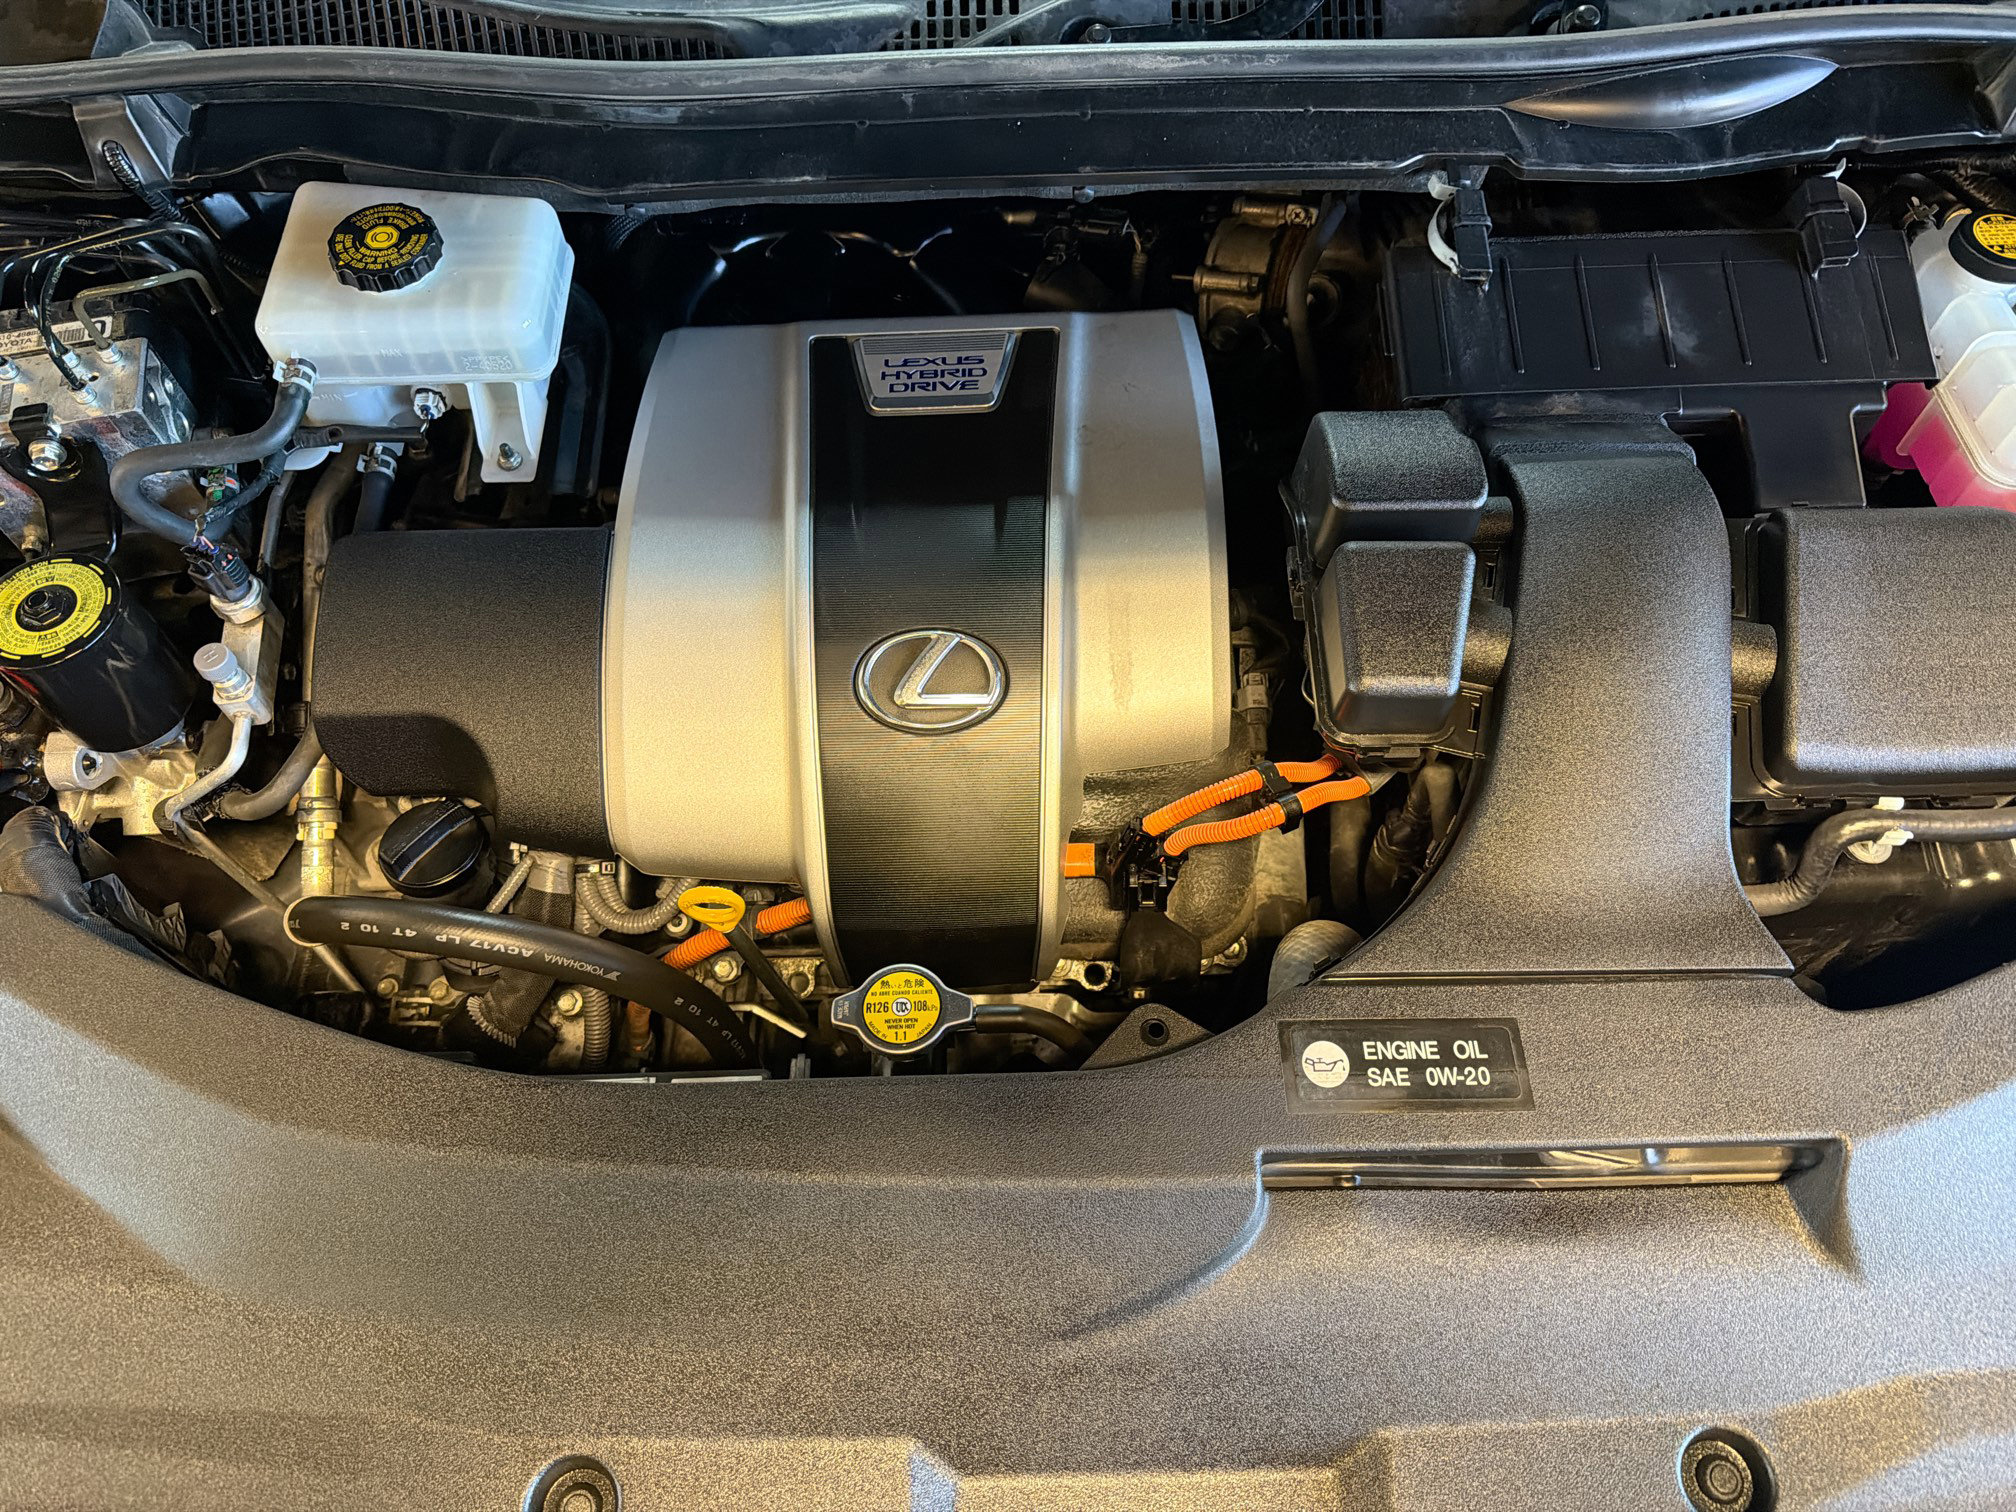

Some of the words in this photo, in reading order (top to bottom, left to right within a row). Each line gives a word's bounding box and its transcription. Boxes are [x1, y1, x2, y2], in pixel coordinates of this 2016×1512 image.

[362, 217, 383, 230] FLUID
[359, 246, 398, 257] WARNING
[377, 253, 400, 263] BEFORE
[350, 260, 365, 269] FLUID
[390, 254, 411, 267] SEALED
[883, 355, 985, 368] LEXUS
[881, 367, 988, 381] HYBRID
[888, 379, 980, 393] DRIVE
[340, 921, 350, 931] 2
[360, 923, 379, 933] 10
[392, 927, 417, 938] 4T
[435, 933, 460, 945] LP
[470, 939, 534, 958] ACV17
[544, 953, 604, 976] YOKOHAMA
[880, 979, 925, 990] 熱いと危険
[674, 996, 685, 1006] 2
[865, 1001, 889, 1014] R126
[688, 1004, 702, 1016] 10
[868, 1021, 881, 1035] MADE
[916, 1022, 932, 1037] JAPAN
[894, 1031, 907, 1041] 1.1
[1362, 1040, 1440, 1060] ENGINE
[1453, 1040, 1489, 1059] OIL
[1367, 1067, 1411, 1087] SAE
[1425, 1066, 1491, 1087] 0W-20
